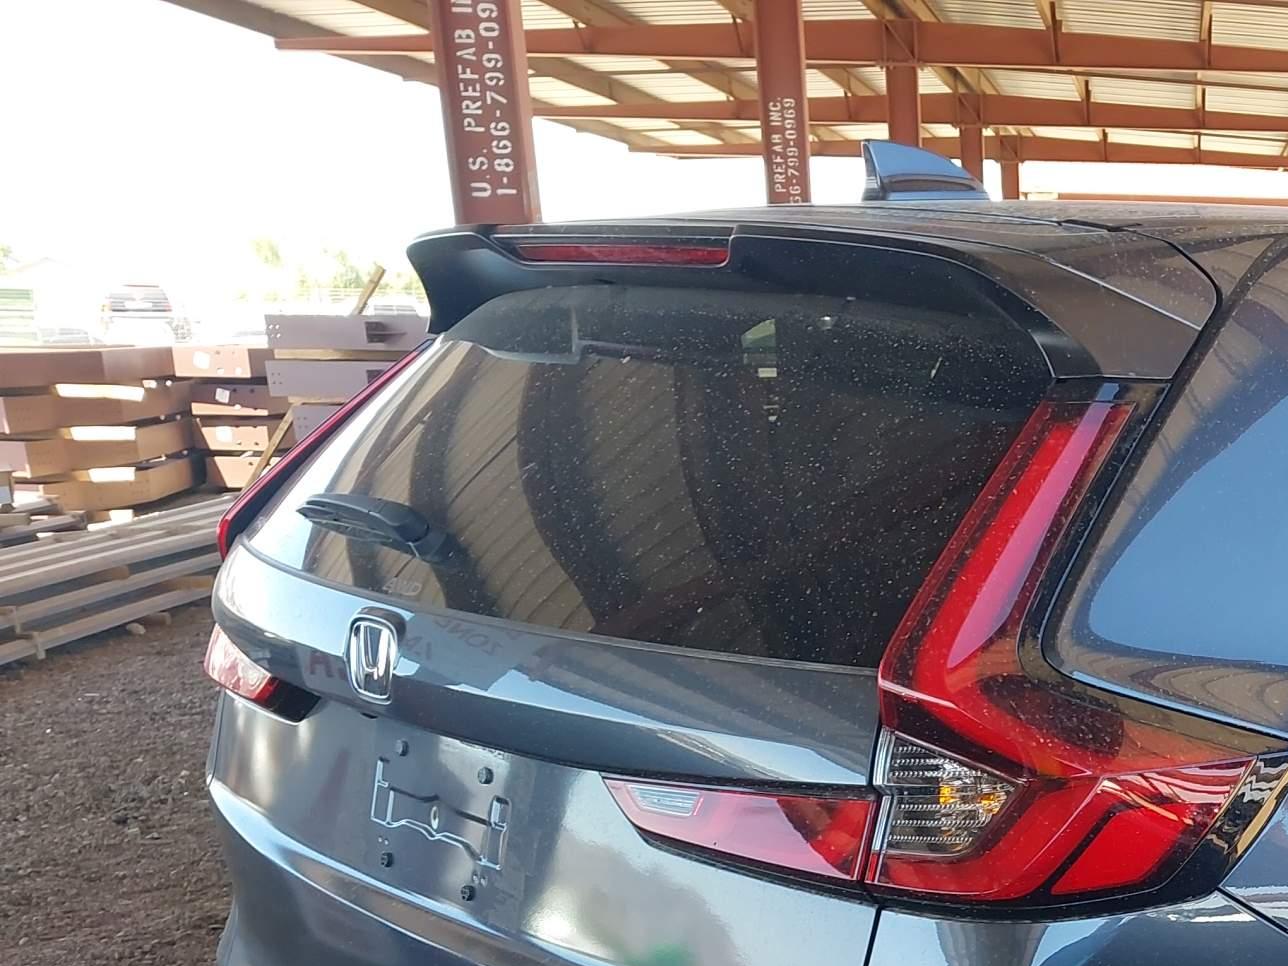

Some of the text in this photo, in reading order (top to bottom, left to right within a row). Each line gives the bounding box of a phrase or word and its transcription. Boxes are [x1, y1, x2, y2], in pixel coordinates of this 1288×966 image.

[454, 29, 486, 132] PREFAB
[468, 148, 492, 198] U.S.
[771, 134, 786, 192] PREFAB
